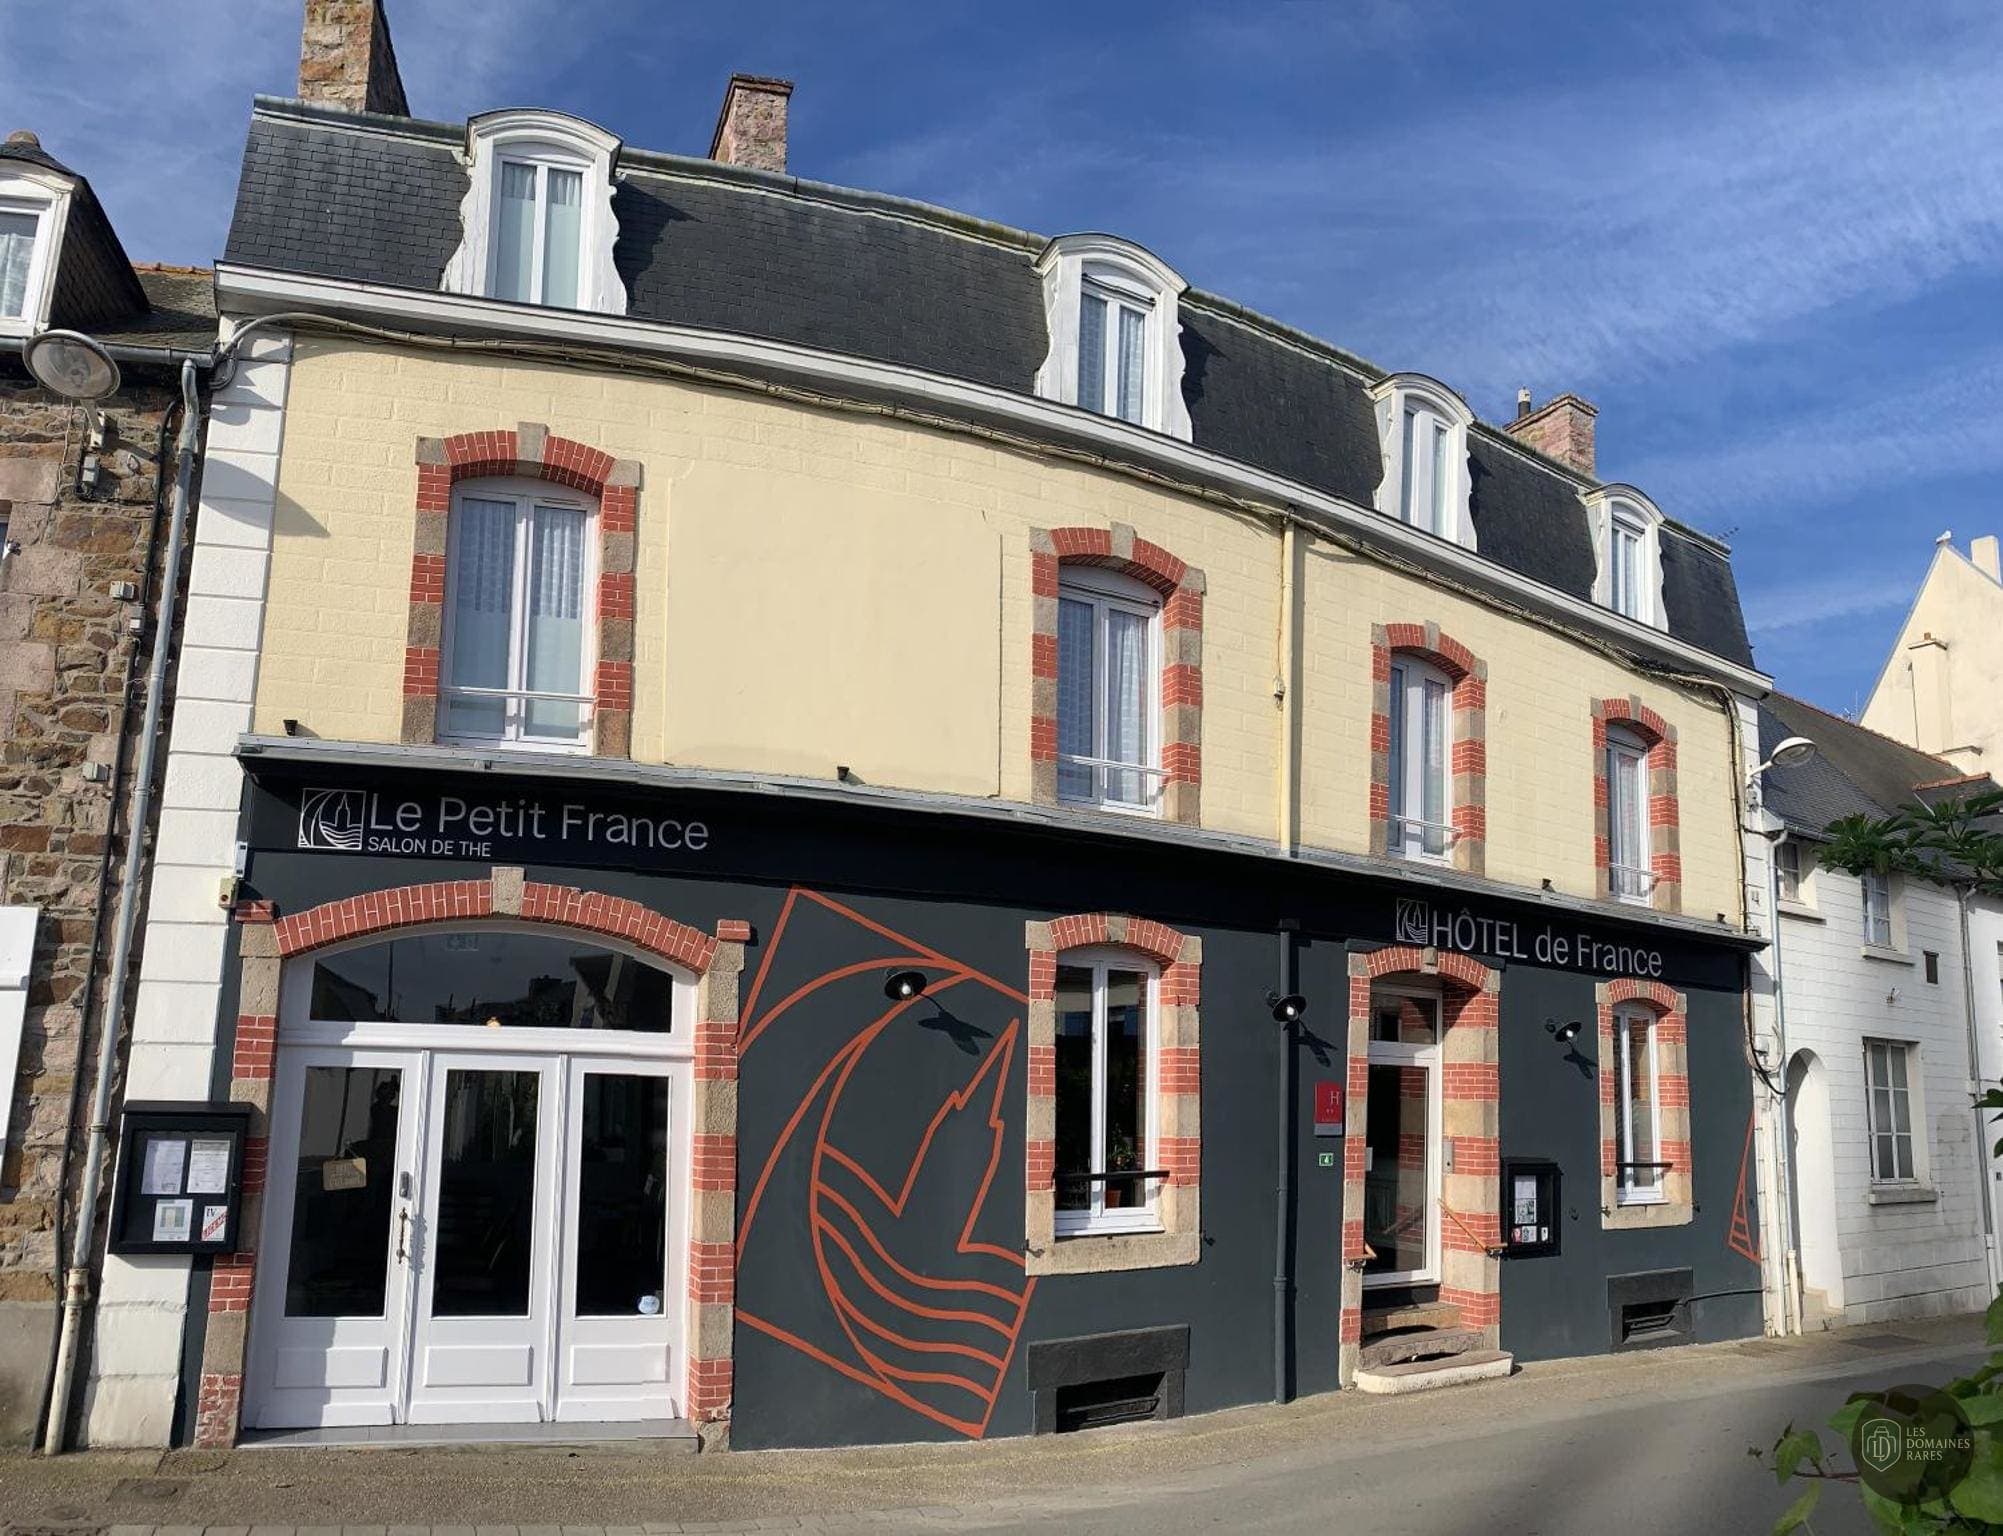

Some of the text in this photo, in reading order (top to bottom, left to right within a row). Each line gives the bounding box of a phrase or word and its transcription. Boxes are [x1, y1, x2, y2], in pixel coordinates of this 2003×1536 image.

[369, 793, 710, 851] Le Petit France
[367, 836, 492, 857] SALON DE THE
[1432, 907, 1663, 977] HÔTEL de France
[1330, 1090, 1340, 1105] H
